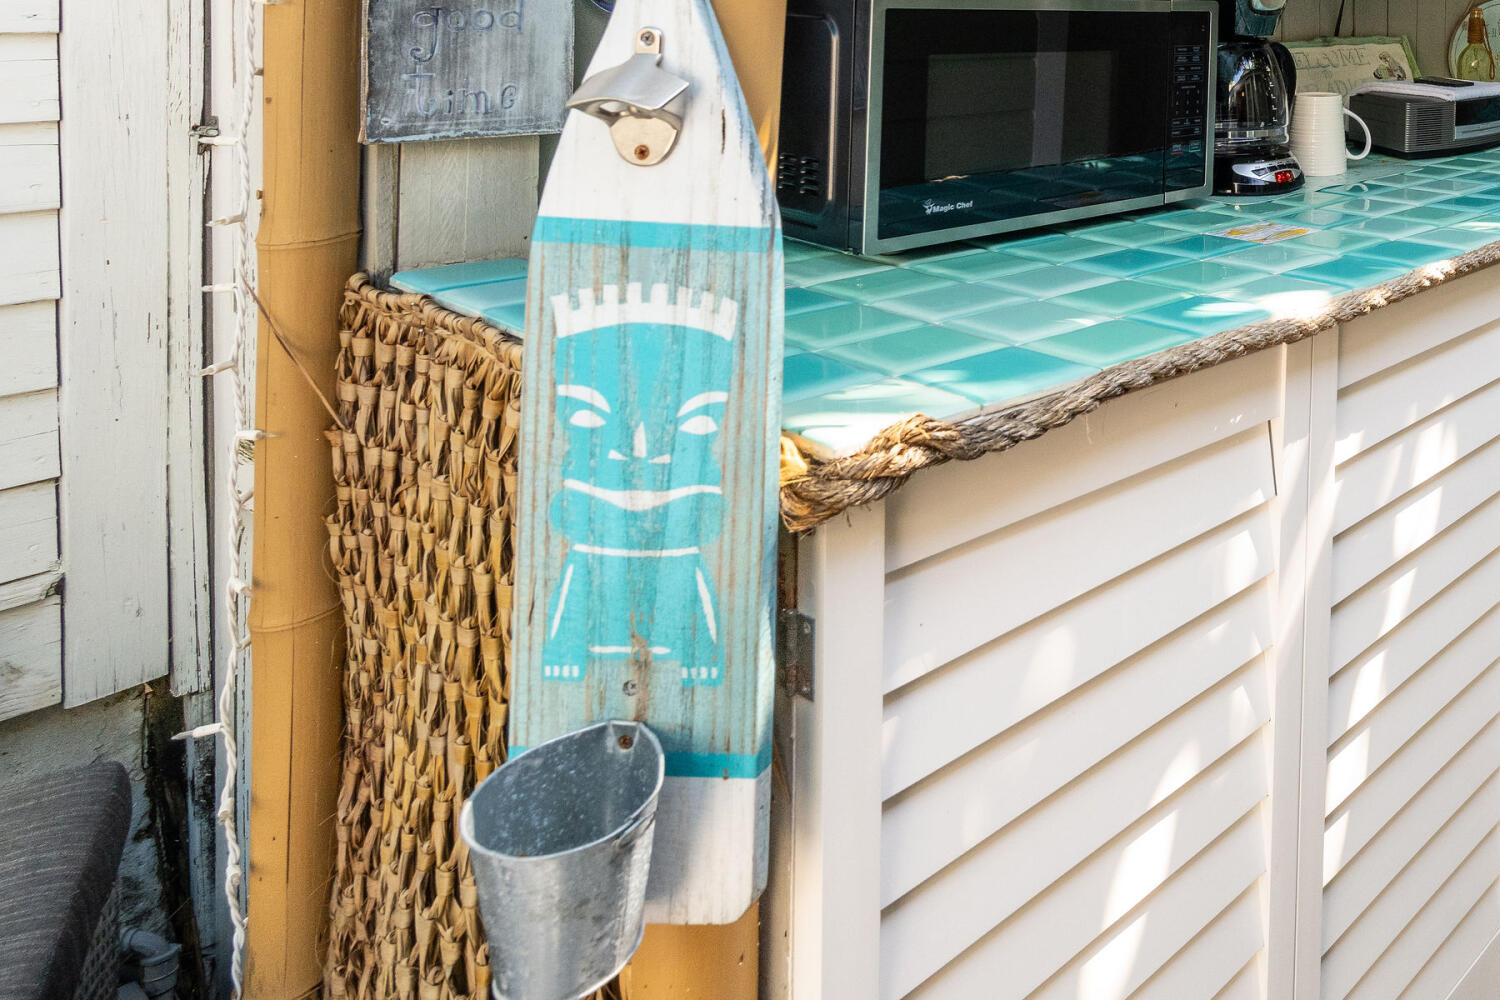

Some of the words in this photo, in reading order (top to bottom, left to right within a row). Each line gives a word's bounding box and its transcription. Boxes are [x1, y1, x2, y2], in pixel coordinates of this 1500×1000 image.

[1292, 47, 1371, 70] ELCOME
[401, 64, 518, 116] time
[932, 203, 954, 213] Magic
[956, 200, 973, 209] Chef
